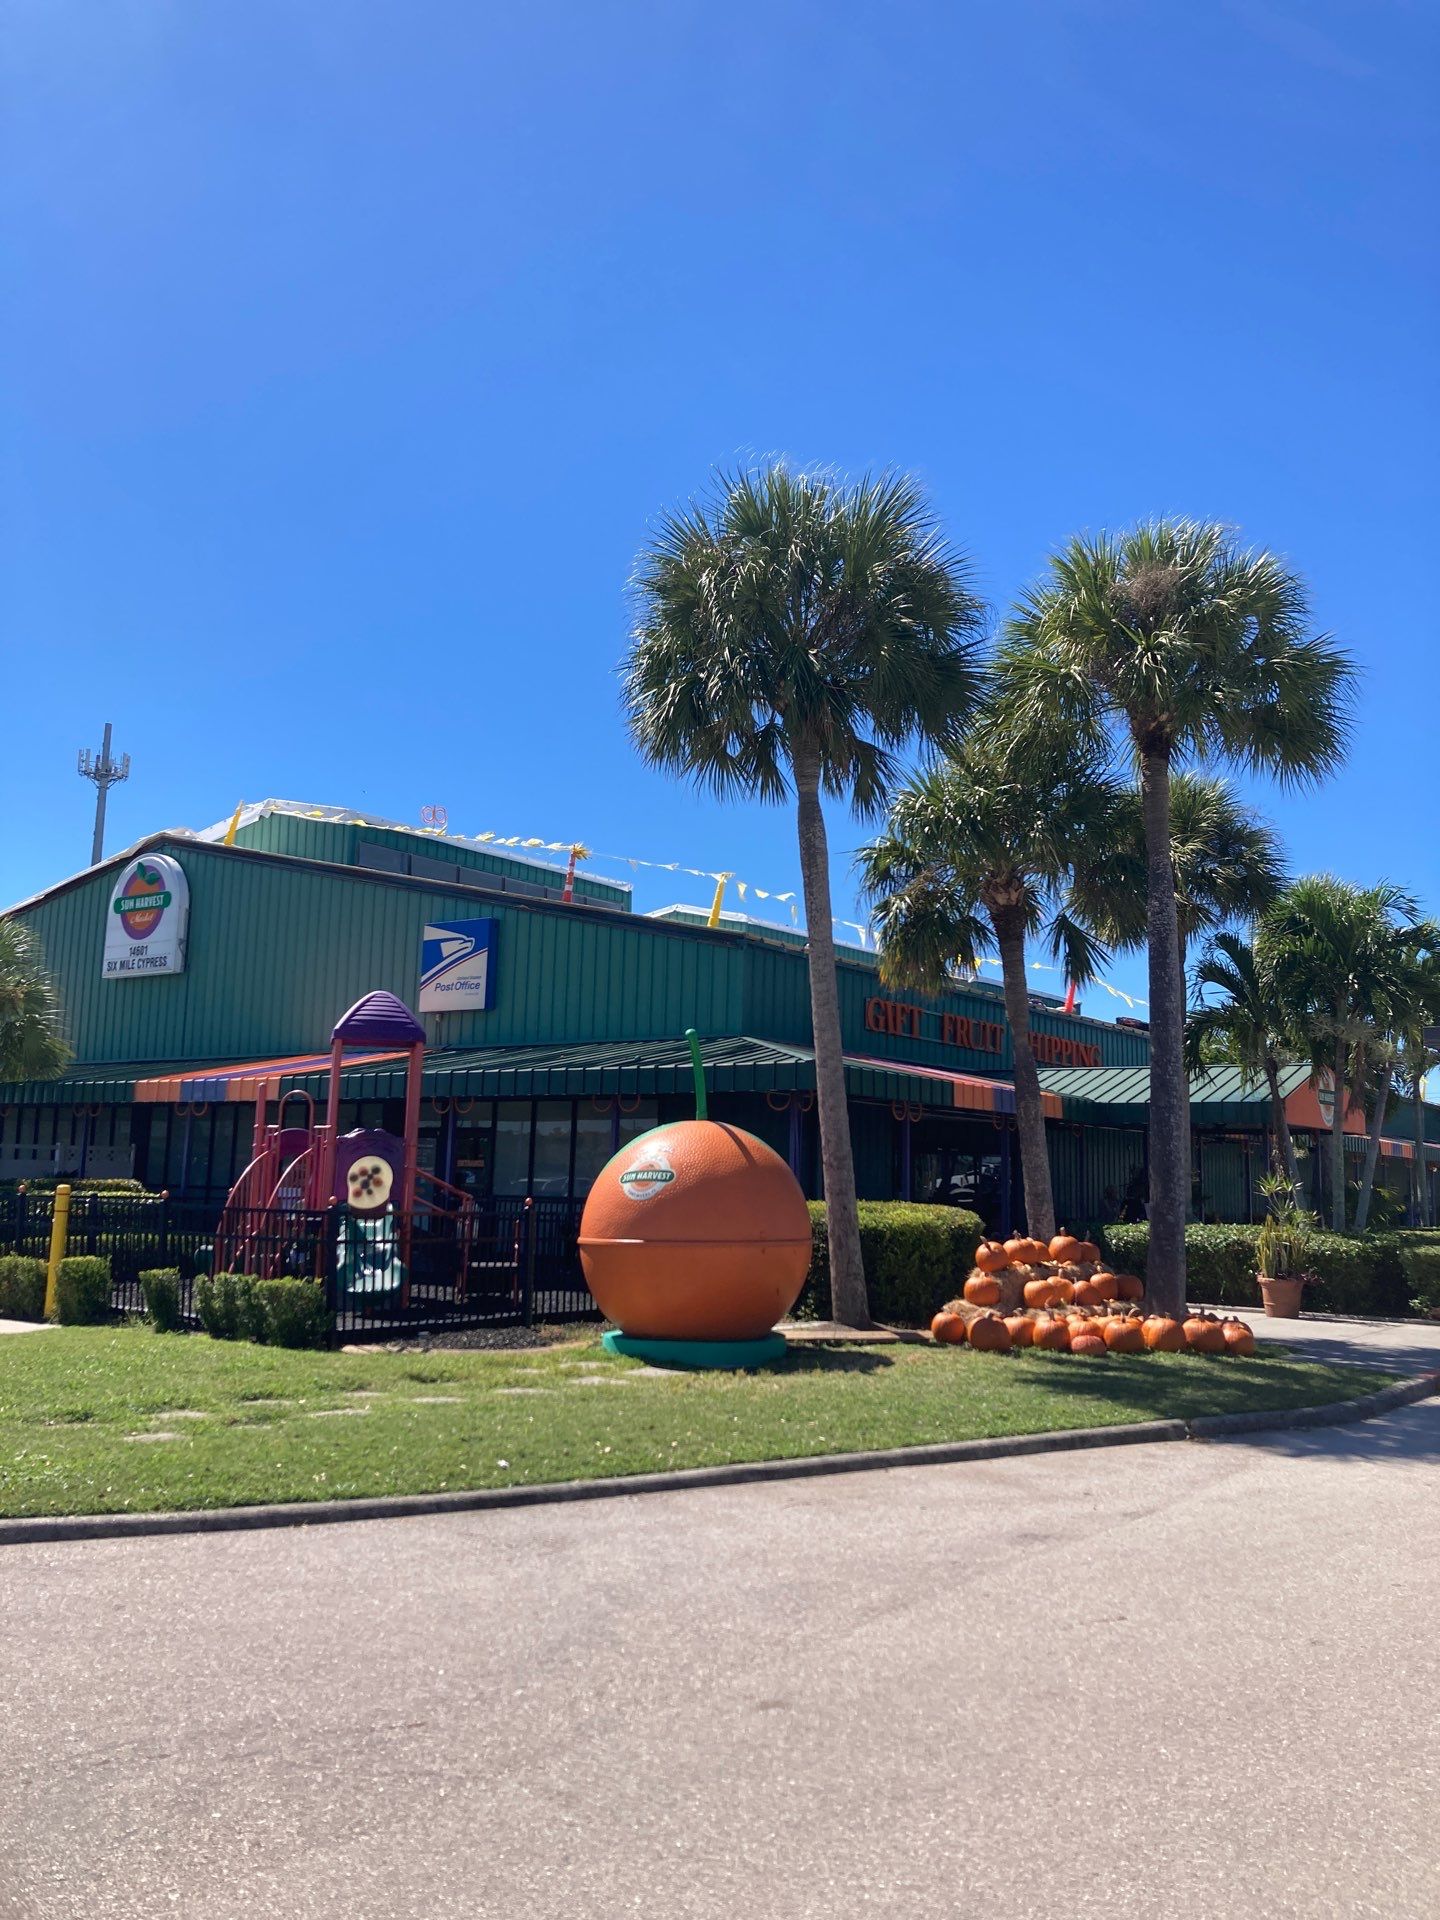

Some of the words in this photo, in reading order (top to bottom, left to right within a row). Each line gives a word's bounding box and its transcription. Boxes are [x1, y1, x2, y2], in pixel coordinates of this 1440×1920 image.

[121, 899, 135, 911] SUN
[135, 894, 165, 909] HARVEST
[129, 945, 149, 957] 14601
[107, 961, 118, 972] SIX
[119, 959, 136, 970] MILE
[136, 956, 168, 969] CYPRESS
[434, 981, 454, 992] Post
[454, 980, 481, 991] Office
[866, 997, 921, 1038] GIFT
[942, 1013, 1004, 1054] FRUIT
[1029, 1032, 1101, 1067] HIPPING
[621, 1173, 636, 1183] SUN
[636, 1171, 672, 1181] HARVEST
